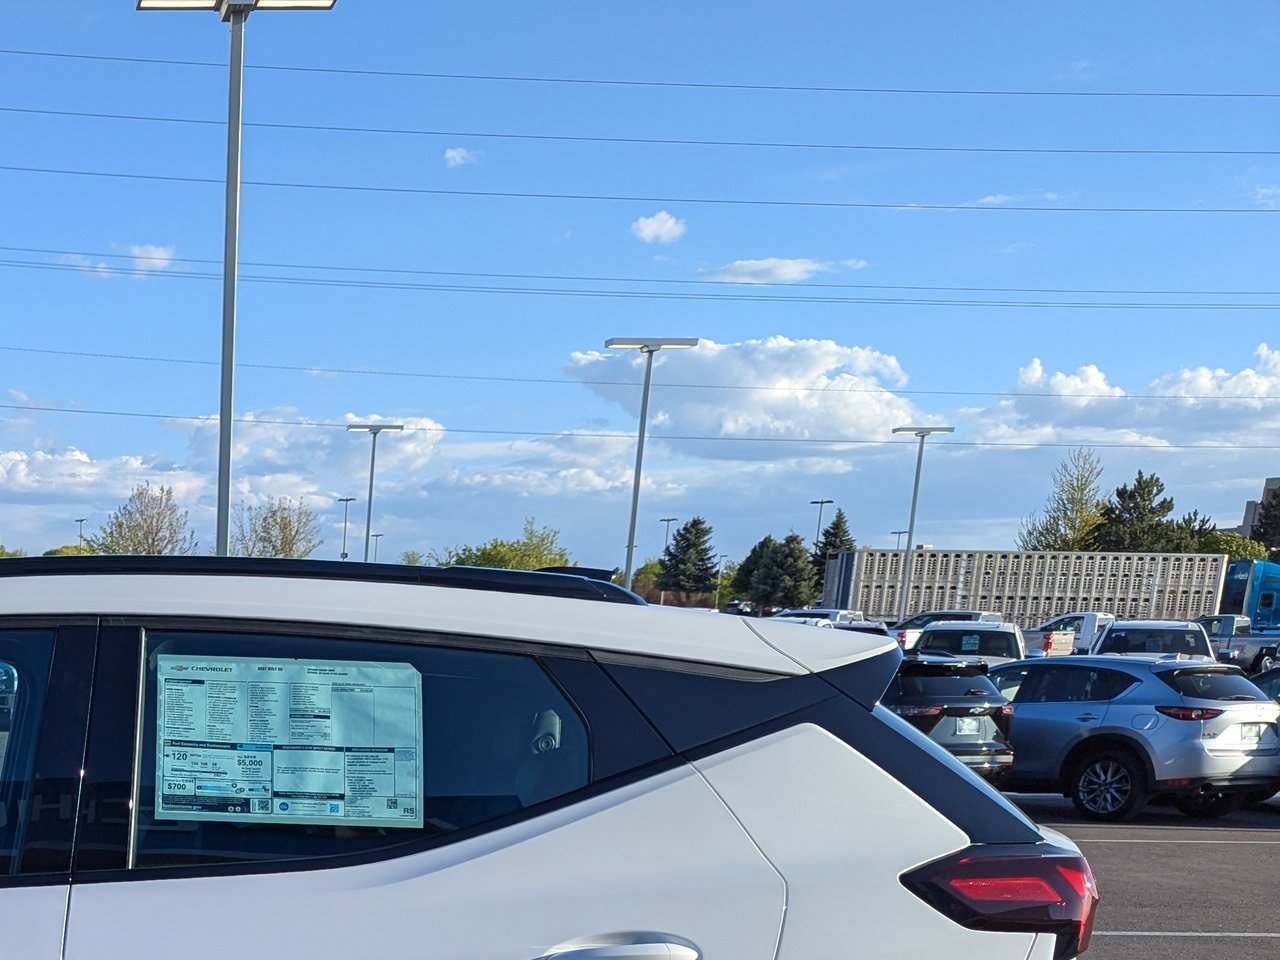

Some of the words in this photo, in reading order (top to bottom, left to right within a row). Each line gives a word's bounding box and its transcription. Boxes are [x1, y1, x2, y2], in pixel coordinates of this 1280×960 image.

[171, 752, 188, 760] 120
[237, 758, 263, 767] $5,000
[167, 782, 186, 790] $700
[403, 807, 415, 815] RS
